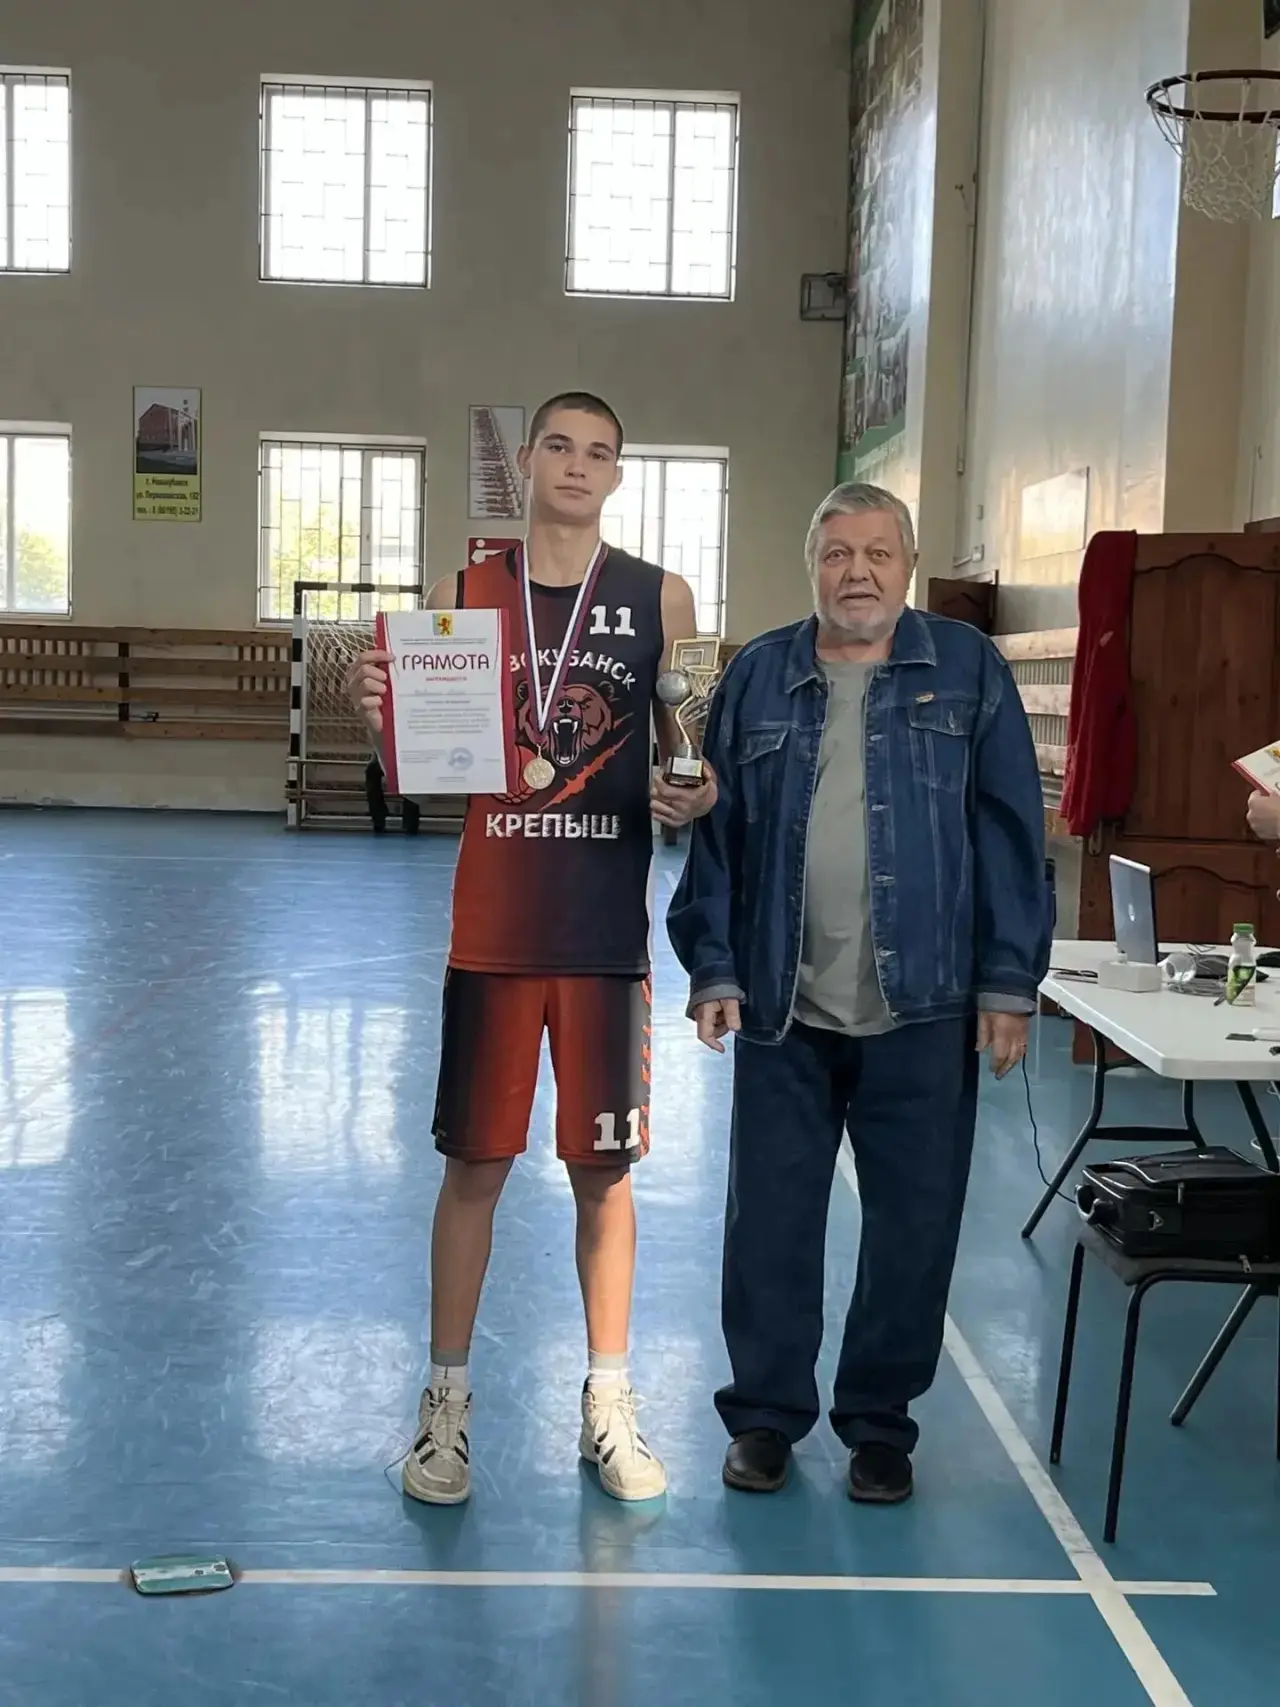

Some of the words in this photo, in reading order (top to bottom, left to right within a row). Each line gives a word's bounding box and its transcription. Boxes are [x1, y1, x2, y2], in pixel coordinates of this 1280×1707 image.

[589, 605, 636, 637] 11
[401, 653, 490, 671] ГРАМОТА
[486, 812, 622, 839] КРЕПЫШ
[593, 1107, 640, 1151] 11
